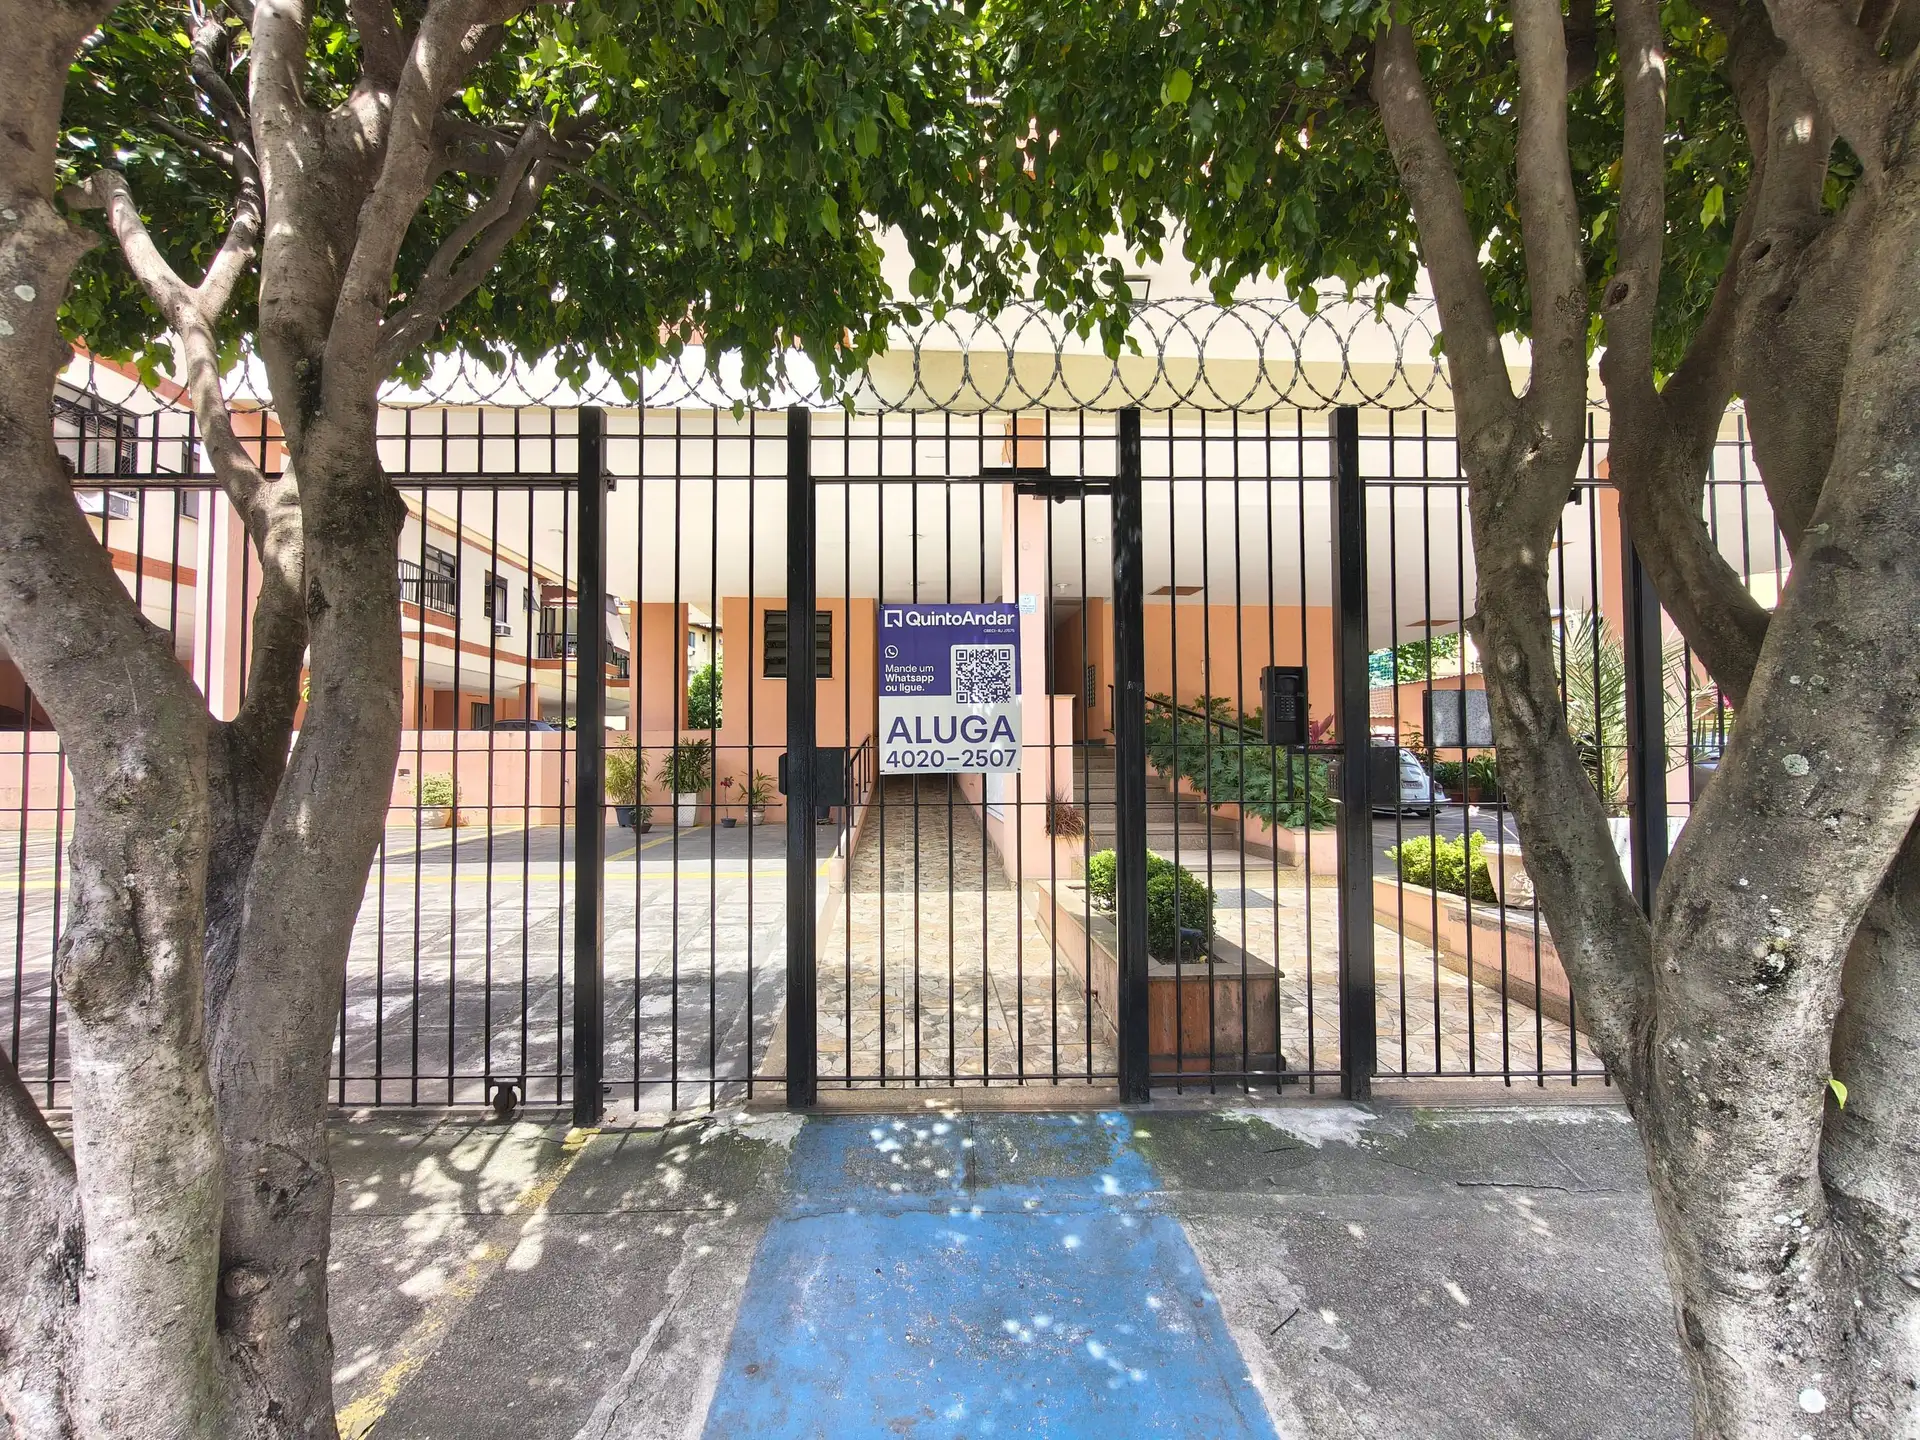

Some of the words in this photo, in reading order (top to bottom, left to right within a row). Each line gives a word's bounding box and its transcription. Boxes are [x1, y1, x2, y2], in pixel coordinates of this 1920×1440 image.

[905, 611, 1015, 627] QuintoAndar
[885, 664, 918, 673] Mande
[919, 665, 934, 673] um
[885, 673, 934, 684] Whatsapp
[885, 684, 898, 692] ou
[899, 682, 925, 693] ligue.
[886, 715, 1016, 744] ALUGA
[886, 749, 1017, 768] 4020-2507
